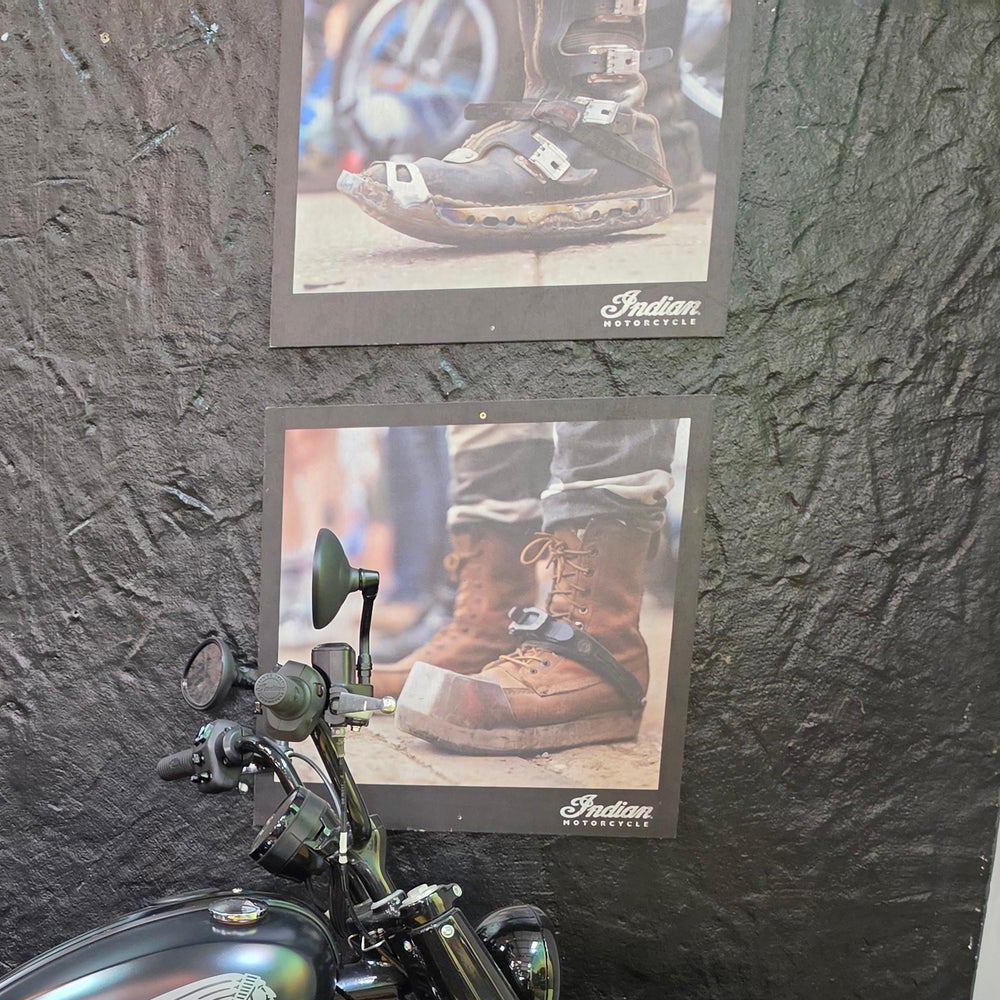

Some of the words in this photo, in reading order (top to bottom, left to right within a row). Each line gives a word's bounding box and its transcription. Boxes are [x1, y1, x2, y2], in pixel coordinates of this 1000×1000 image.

[600, 289, 702, 318] Indian
[603, 318, 697, 328] MOTORCYCLE
[559, 794, 654, 819] Indian
[563, 819, 649, 828] MOTORCYCLE
